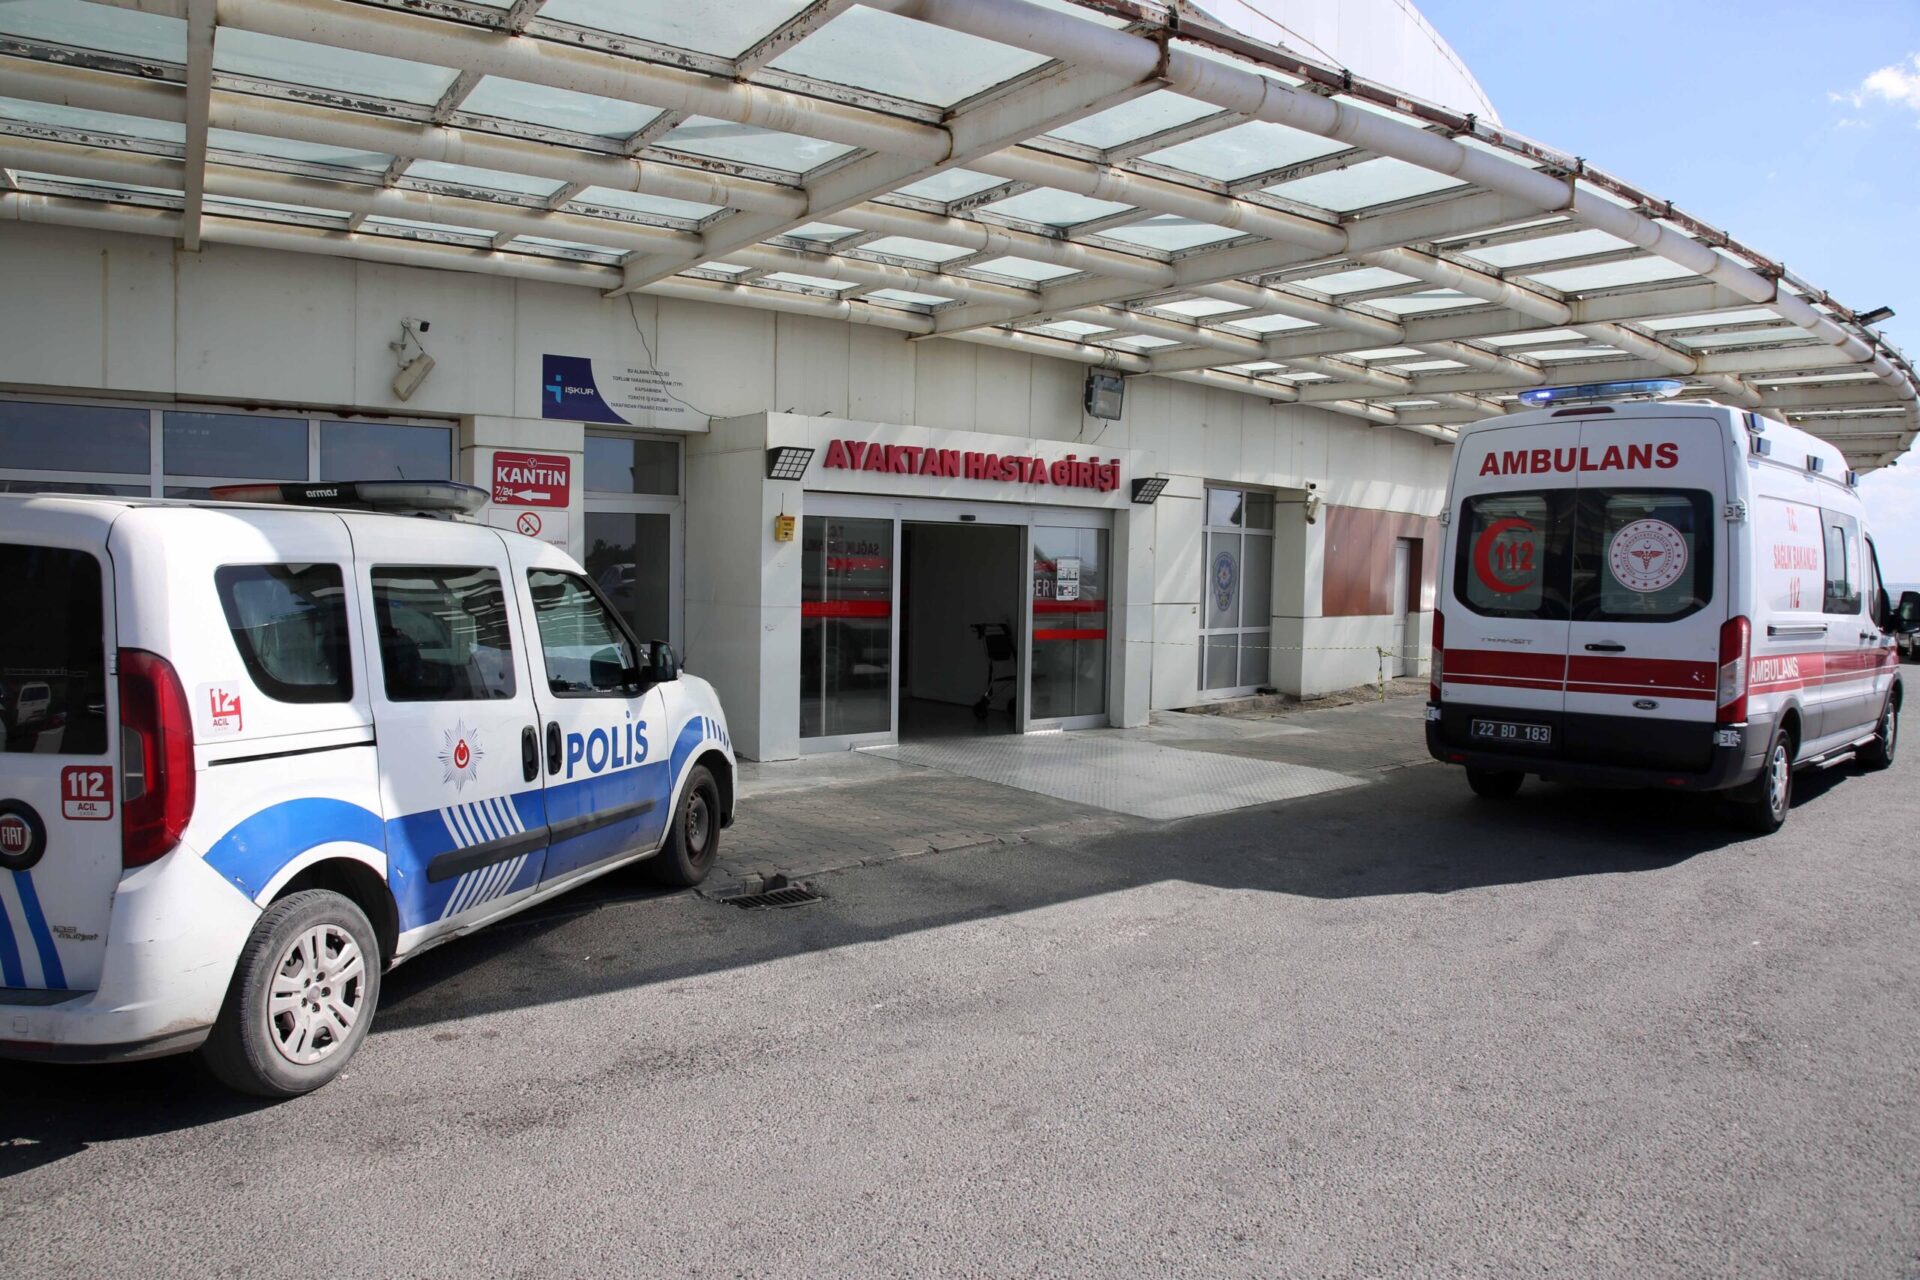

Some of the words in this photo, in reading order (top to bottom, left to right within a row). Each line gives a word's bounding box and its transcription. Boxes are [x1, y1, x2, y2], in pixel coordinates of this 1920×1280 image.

[823, 439, 960, 477] AYAKTAN
[964, 451, 1049, 484] HASTA
[1051, 454, 1120, 492] GİRİŞİ
[1478, 442, 1679, 476] AMBULANS
[305, 488, 338, 499] armas
[495, 486, 513, 497] 7/24
[1495, 541, 1535, 571] 112
[1789, 577, 1801, 609] 112
[1750, 656, 1799, 683] AMBULANS
[566, 710, 649, 779] POLİS
[1478, 722, 1495, 736] 22
[1501, 724, 1517, 738] BD
[1525, 727, 1549, 741] 183
[68, 772, 105, 797] 112
[1, 826, 23, 846] FIAT
